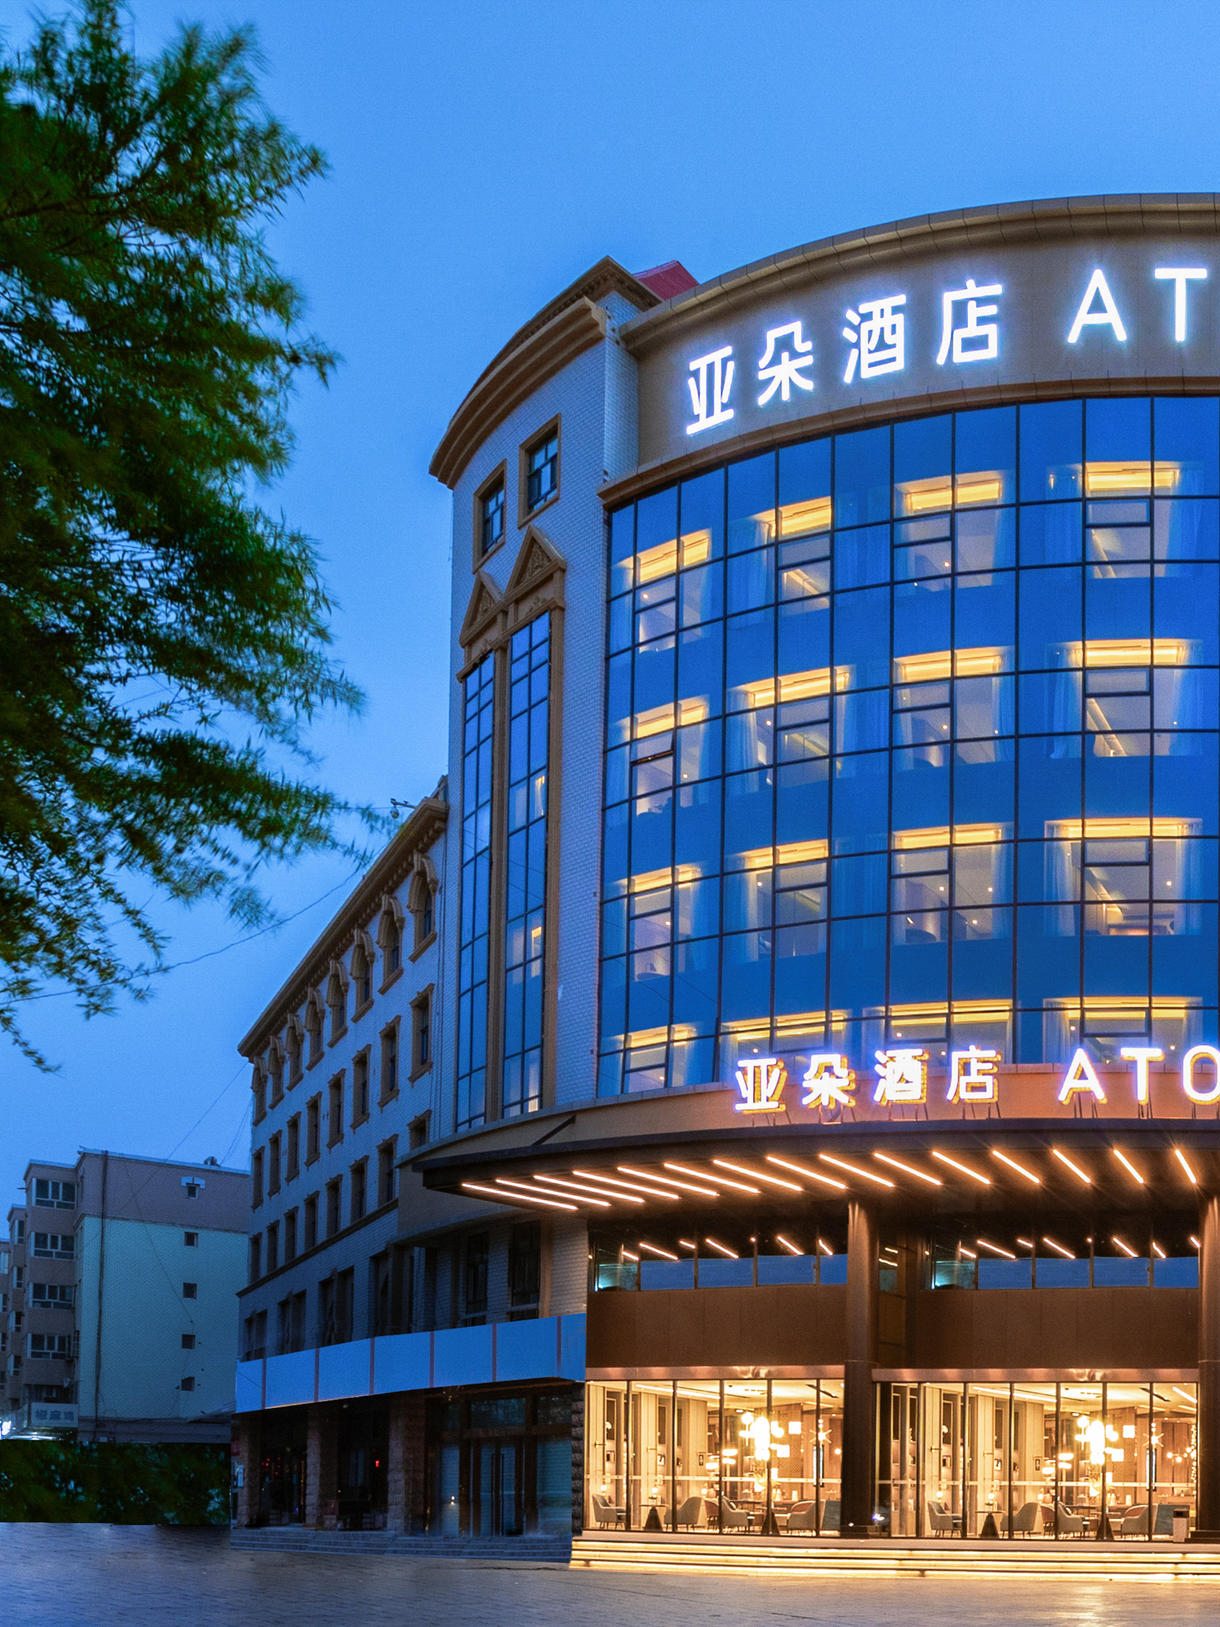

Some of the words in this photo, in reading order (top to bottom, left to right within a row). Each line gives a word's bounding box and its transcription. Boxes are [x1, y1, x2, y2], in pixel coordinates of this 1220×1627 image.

[686, 279, 1003, 436] 亚朵酒店
[735, 1046, 1000, 1112] 亚朵酒店
